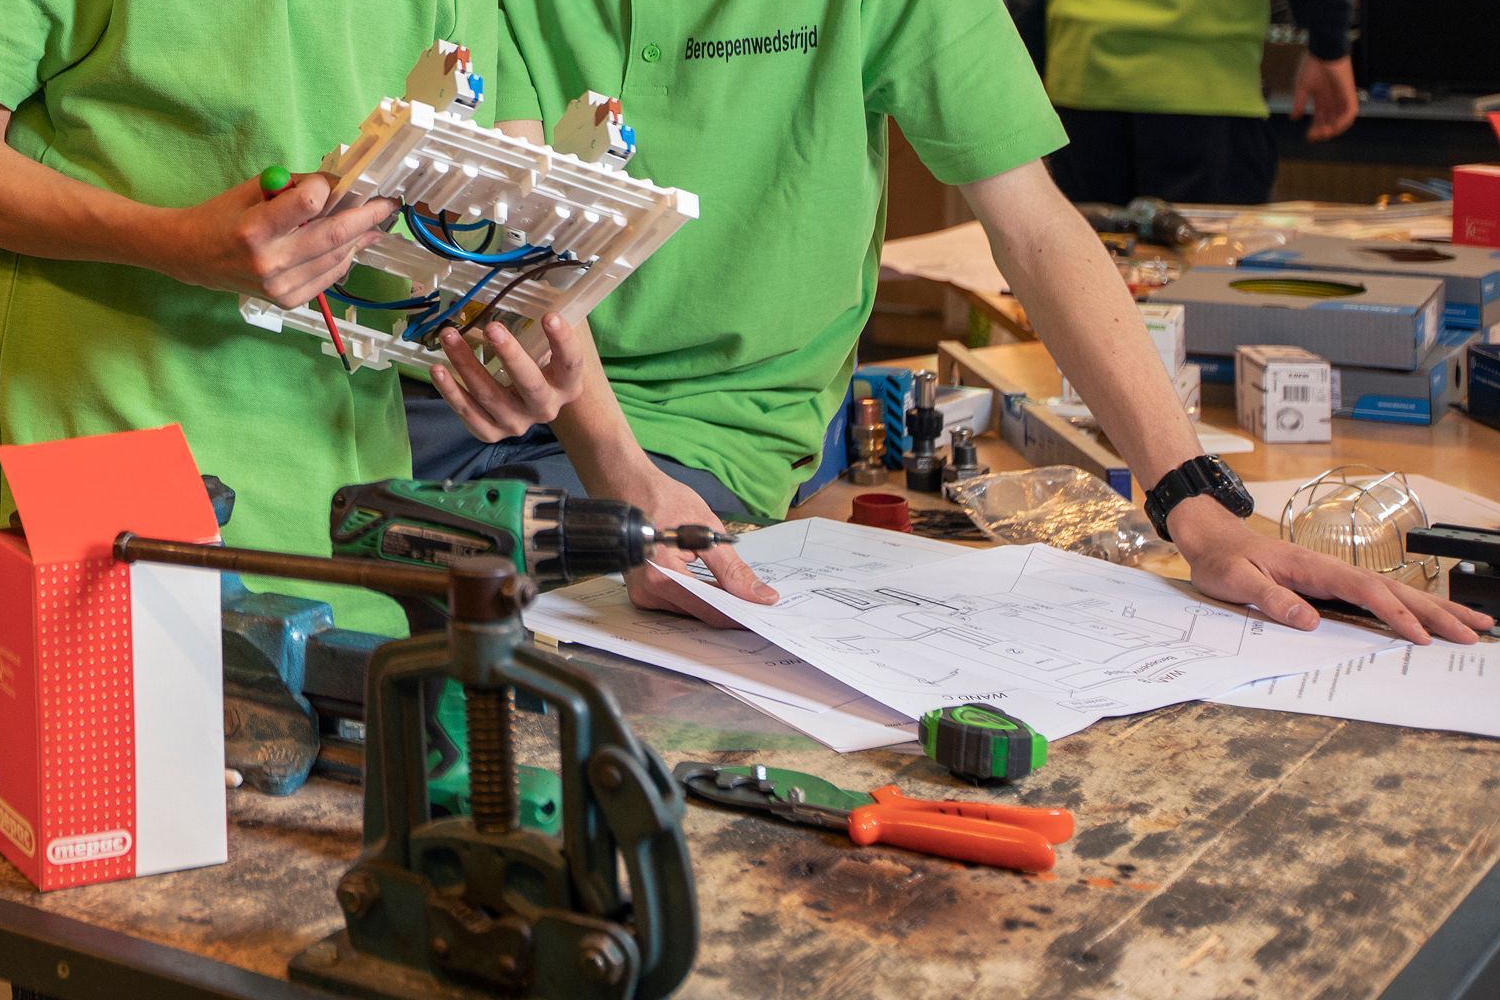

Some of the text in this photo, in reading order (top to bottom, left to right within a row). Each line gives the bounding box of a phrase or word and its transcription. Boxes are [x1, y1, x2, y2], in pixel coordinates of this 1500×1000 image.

[685, 24, 818, 63] Beroepenwedstrijd
[958, 692, 1009, 701] WAND
[53, 837, 126, 860] mepac
